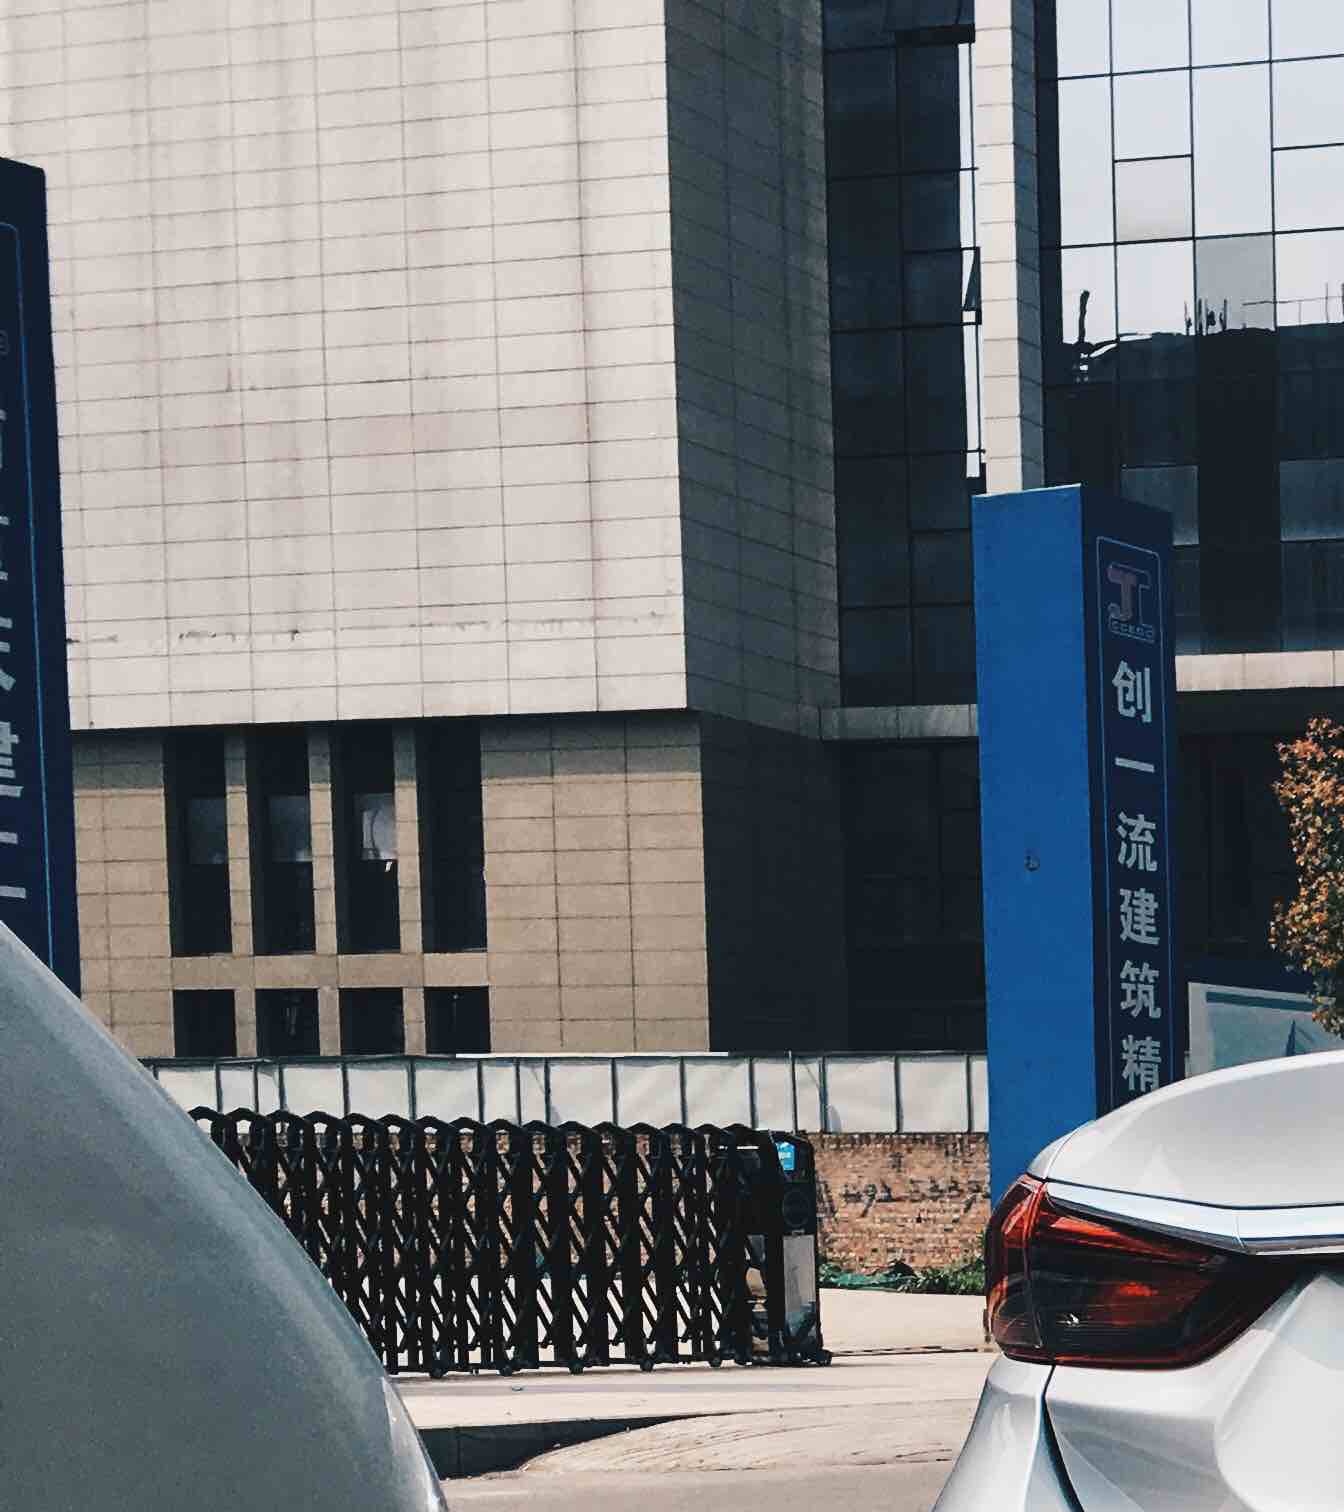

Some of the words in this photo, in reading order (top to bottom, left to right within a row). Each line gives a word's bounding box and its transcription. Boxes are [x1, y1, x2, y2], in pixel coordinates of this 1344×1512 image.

[1111, 660, 1162, 1092] 创一流建筑精
